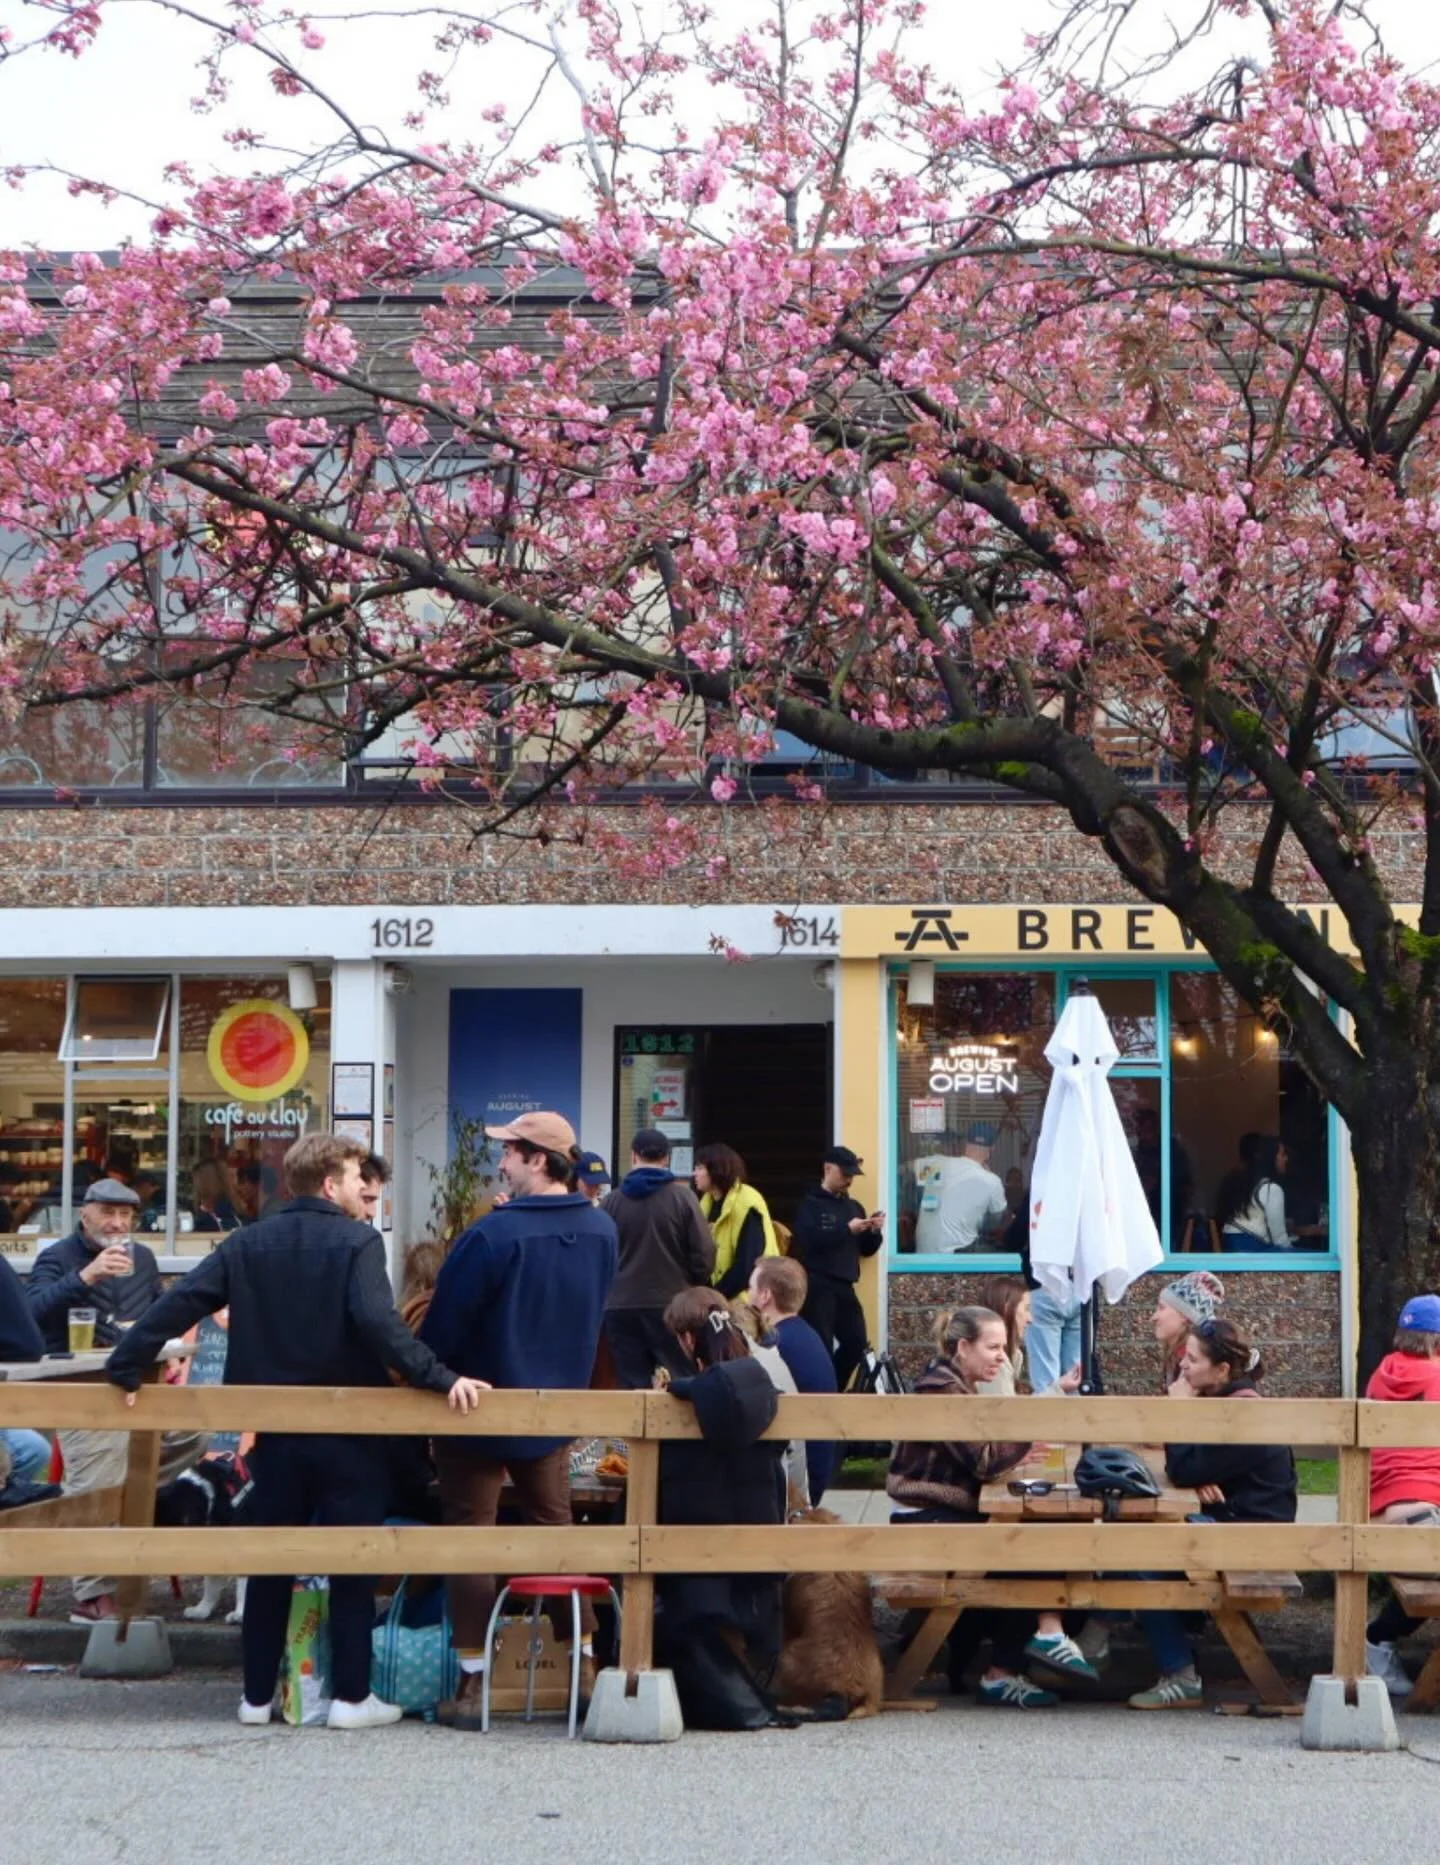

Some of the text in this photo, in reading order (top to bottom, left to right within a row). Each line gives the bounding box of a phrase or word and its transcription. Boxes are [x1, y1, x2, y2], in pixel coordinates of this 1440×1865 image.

[370, 917, 434, 948] 1612
[780, 916, 840, 946] 1614
[1018, 909, 1330, 950] BREN
[929, 1057, 1018, 1073] AUGUST
[929, 1073, 1019, 1094] OPEN
[204, 1097, 309, 1145] café au clay
[486, 1101, 543, 1111] AUGUST
